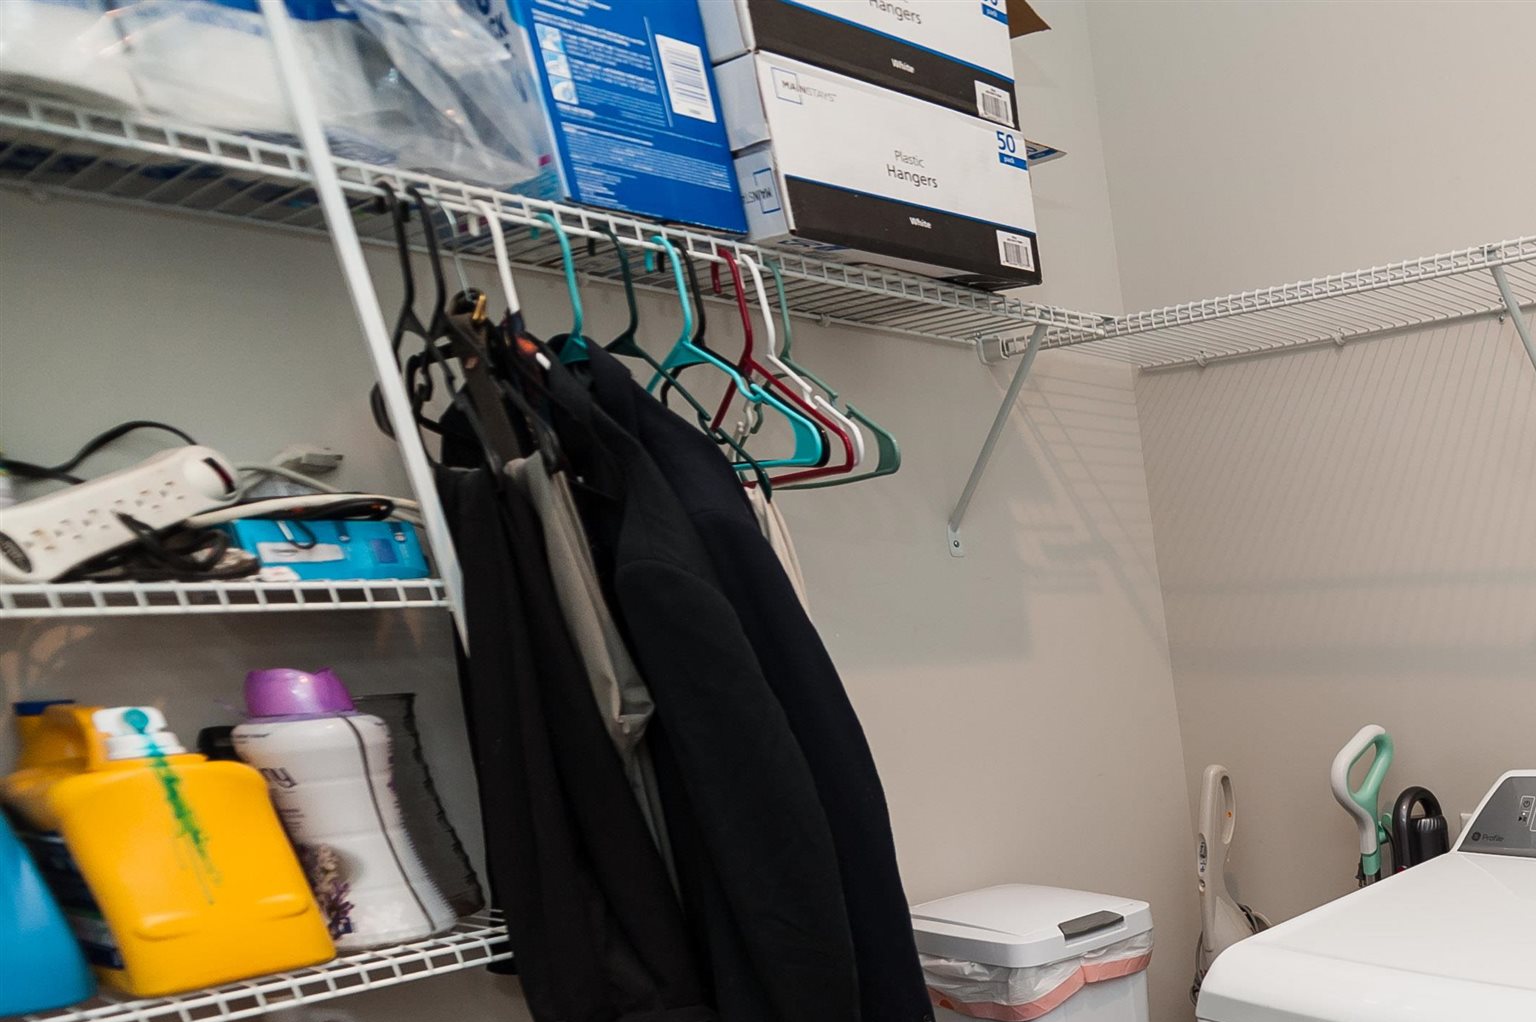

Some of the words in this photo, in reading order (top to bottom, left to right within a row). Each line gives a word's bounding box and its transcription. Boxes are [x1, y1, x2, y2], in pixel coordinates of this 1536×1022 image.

[870, 0, 922, 25] Hangers
[891, 58, 915, 74] White
[996, 130, 1016, 153] 50
[894, 150, 925, 168] Plastic
[887, 164, 938, 188] Hangers
[909, 216, 932, 229] White
